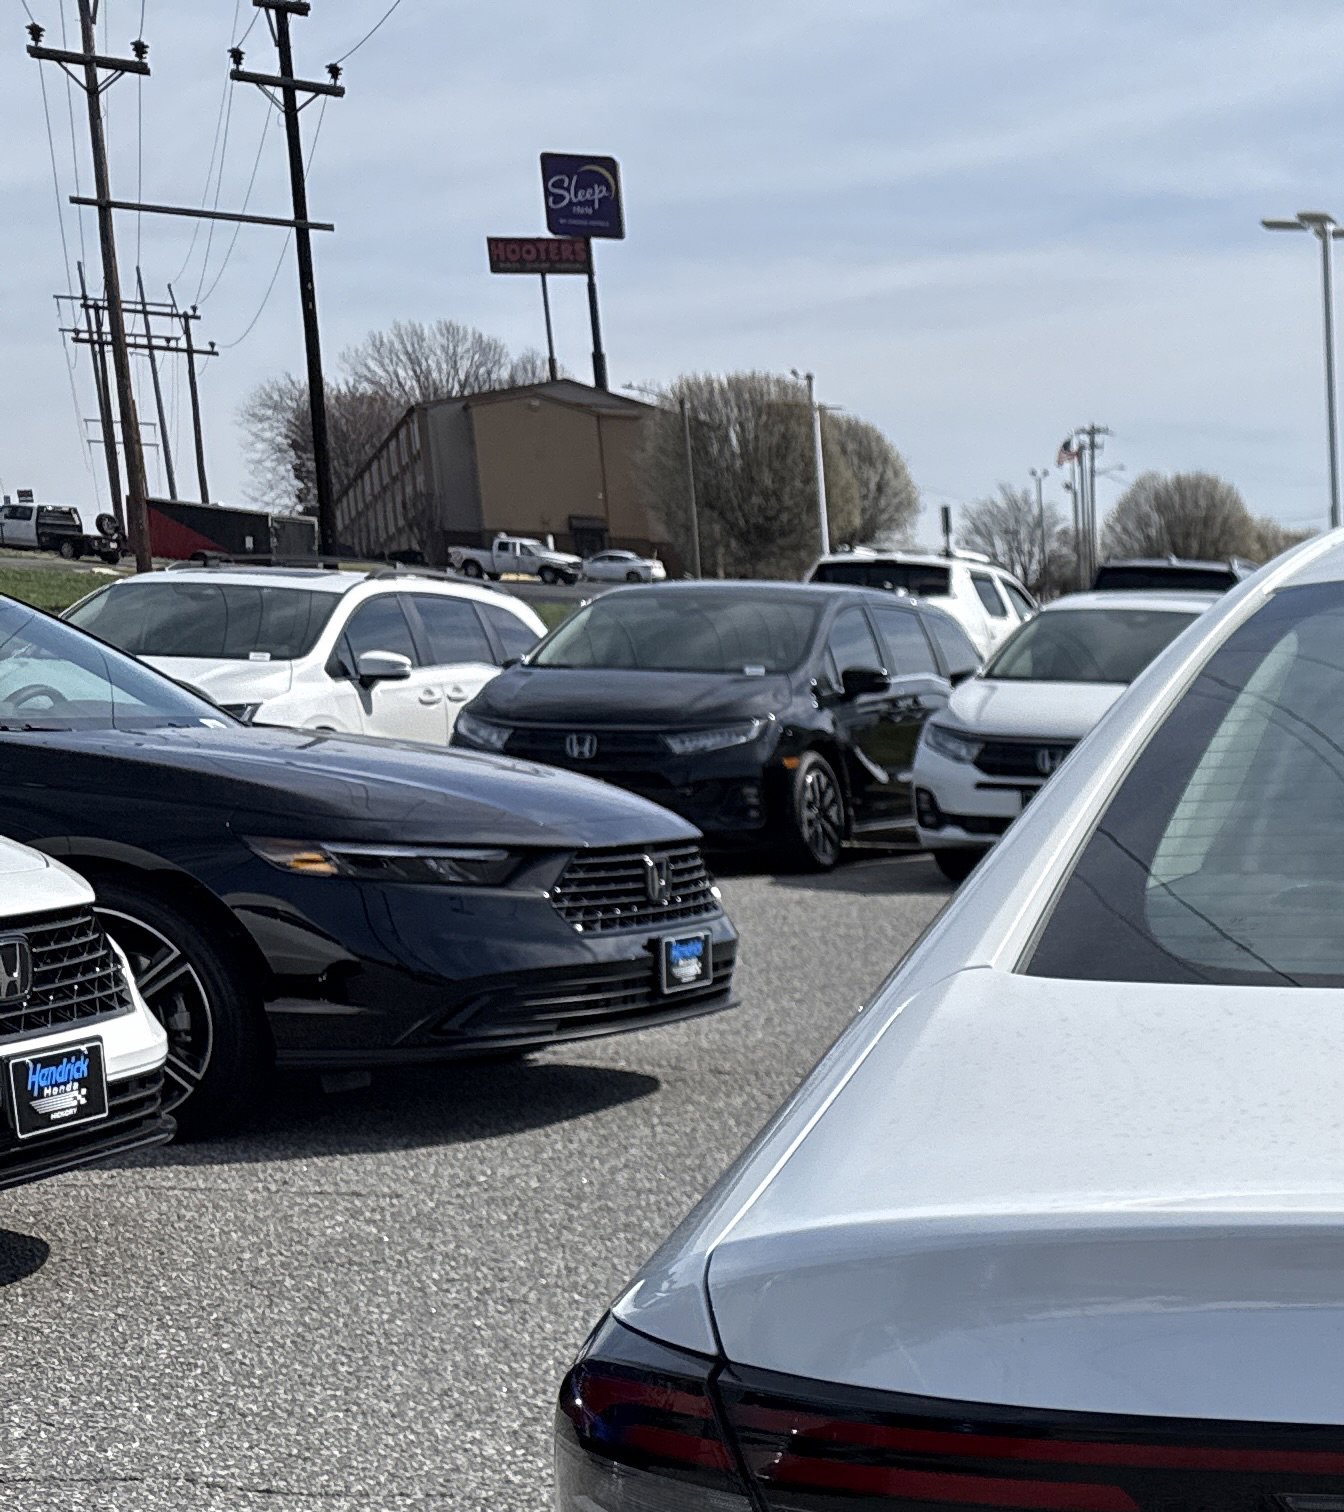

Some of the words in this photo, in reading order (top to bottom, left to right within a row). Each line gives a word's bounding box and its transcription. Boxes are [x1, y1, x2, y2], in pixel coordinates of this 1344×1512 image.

[548, 175, 609, 209] Sleep
[490, 239, 587, 261] HOOTERS
[28, 1055, 89, 1097] Hendrick
[44, 1082, 79, 1097] Honda
